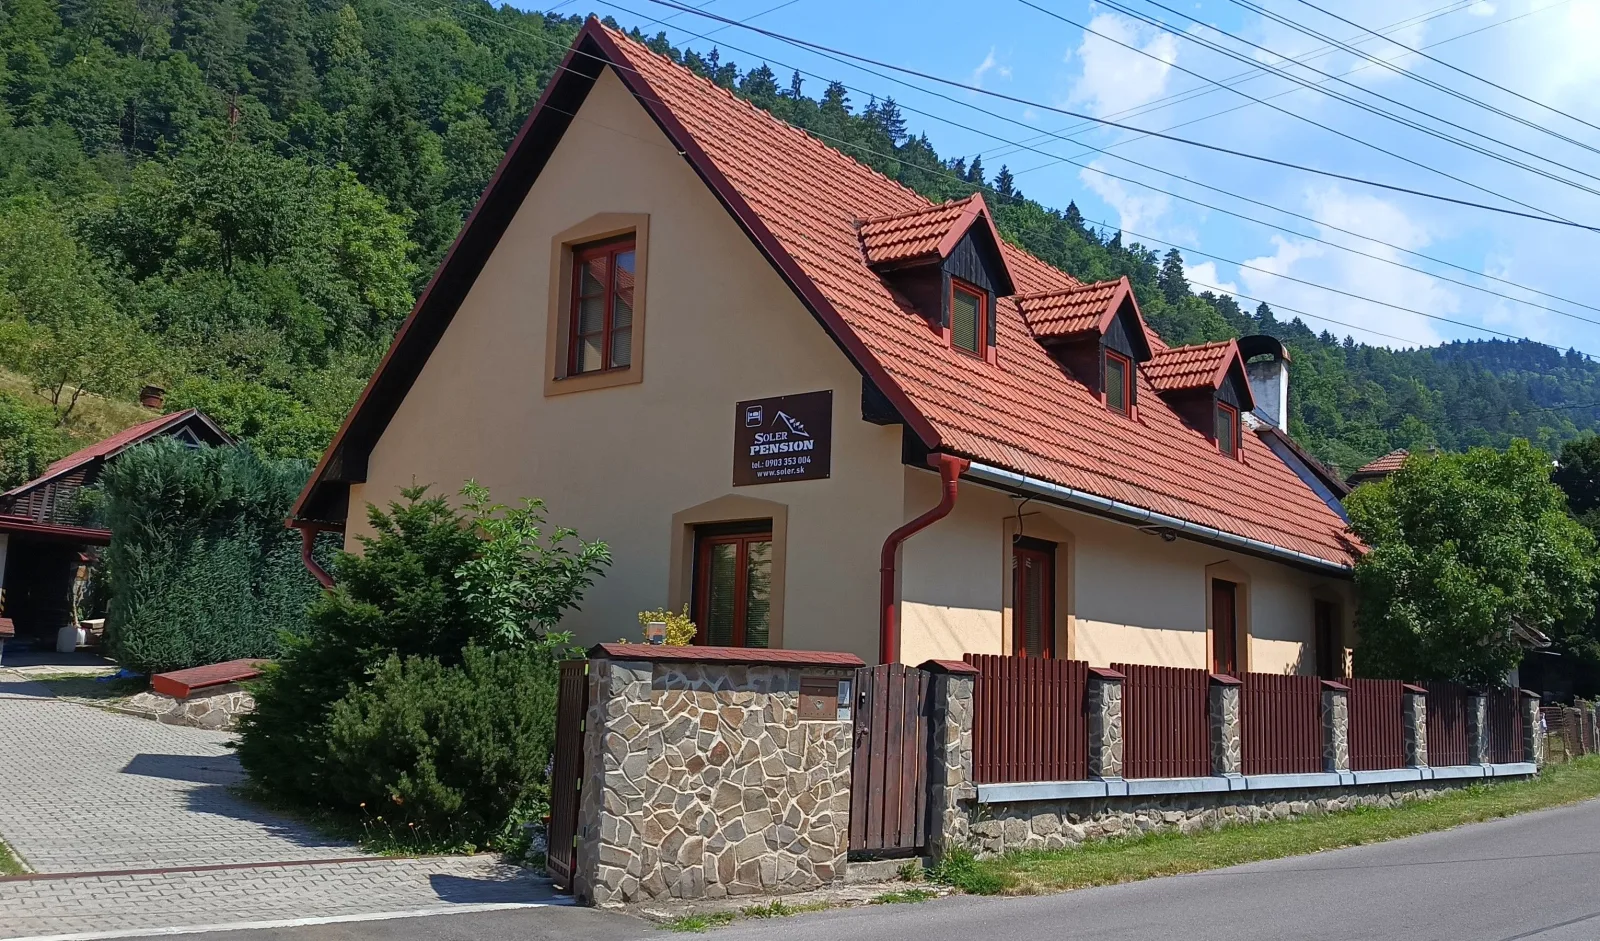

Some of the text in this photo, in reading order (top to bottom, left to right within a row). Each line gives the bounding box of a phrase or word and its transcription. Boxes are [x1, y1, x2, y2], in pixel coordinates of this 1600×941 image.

[749, 439, 815, 456] PENSION
[751, 455, 811, 469] tel.: 0903 353 004
[757, 465, 805, 477] www.soler.sk
